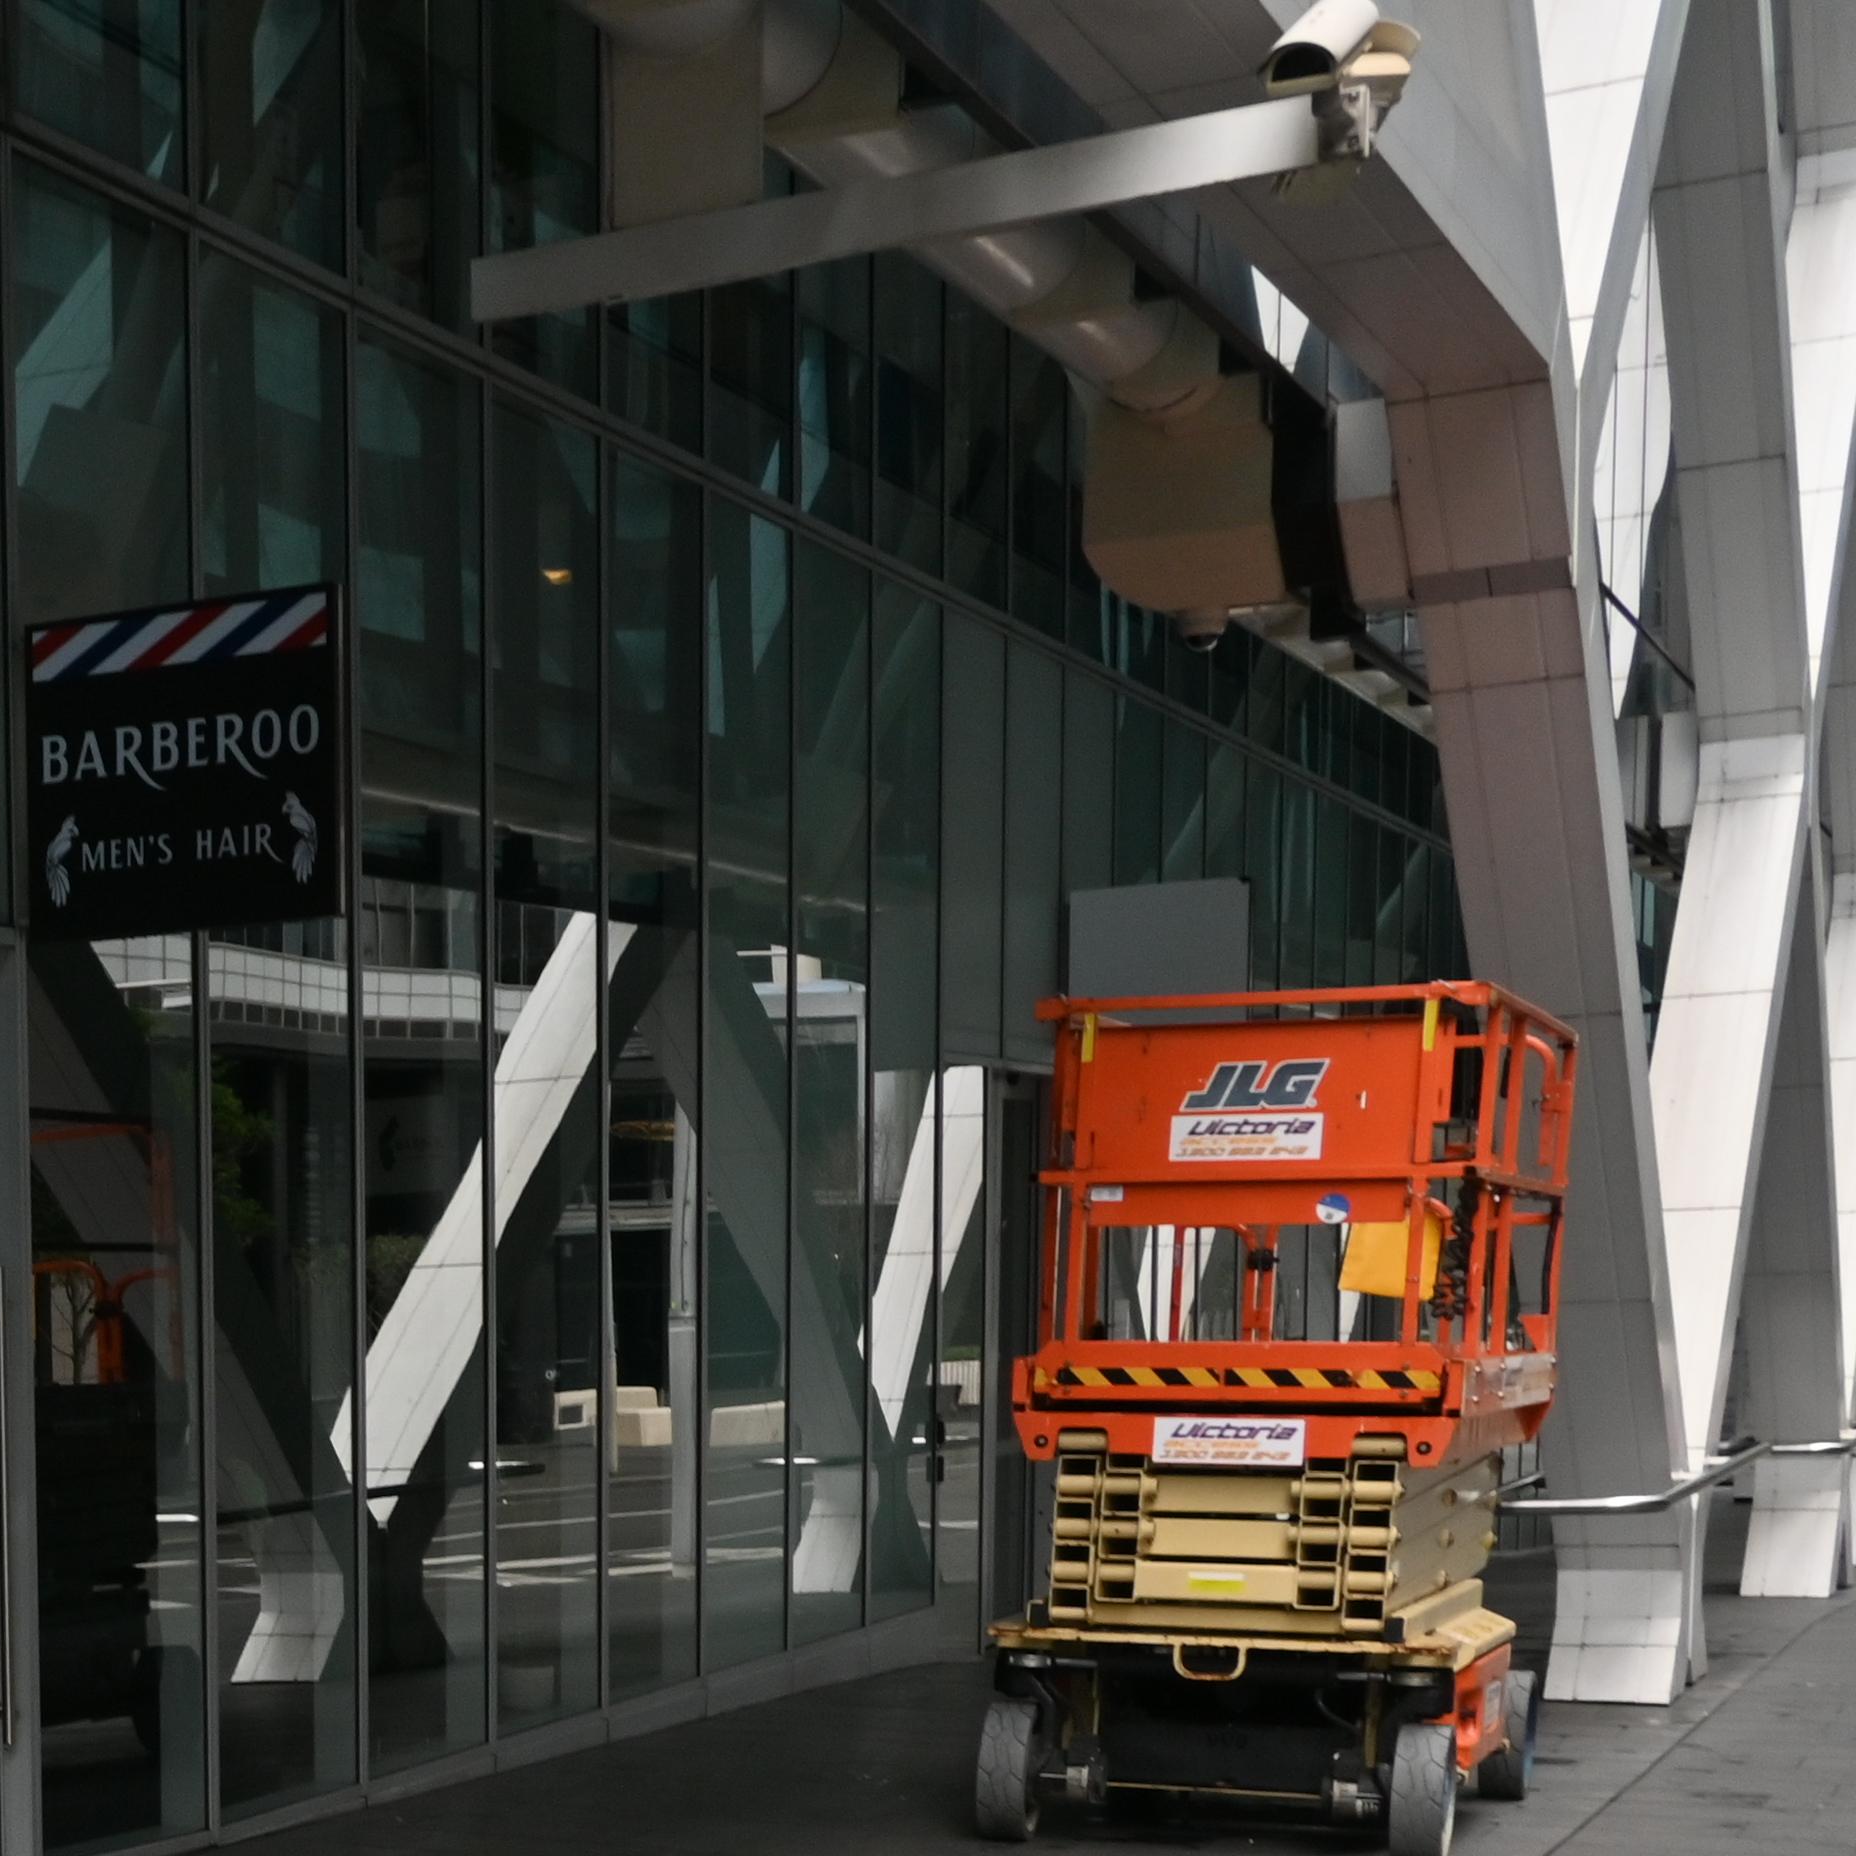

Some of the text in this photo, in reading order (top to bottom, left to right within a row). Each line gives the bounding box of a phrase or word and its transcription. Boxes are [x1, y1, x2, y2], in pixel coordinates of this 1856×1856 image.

[41, 703, 321, 792] BARBEROO
[80, 822, 286, 873] MEN'S HAIR
[1180, 1058, 1329, 1111] JLG
